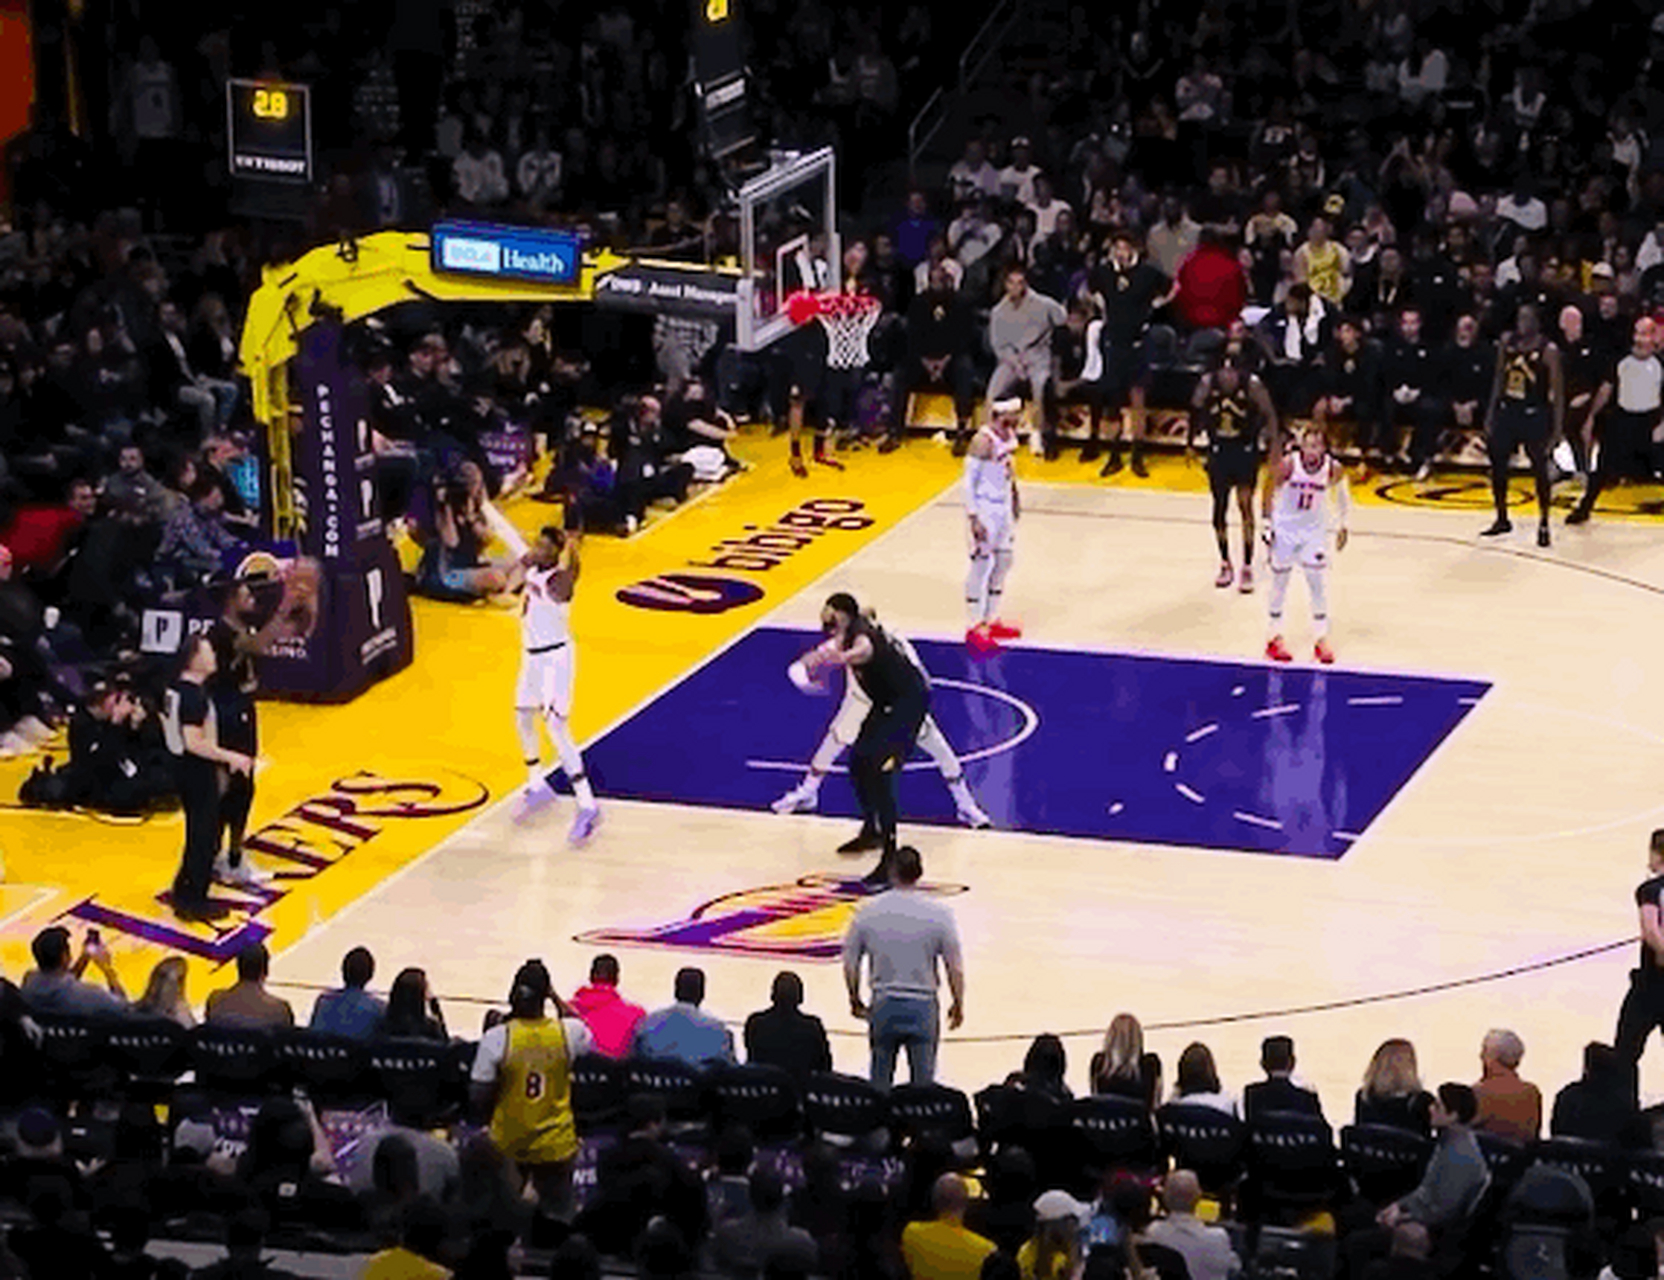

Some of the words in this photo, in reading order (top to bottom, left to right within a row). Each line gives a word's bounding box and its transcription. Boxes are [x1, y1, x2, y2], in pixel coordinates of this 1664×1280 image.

[253, 89, 288, 119] 28
[503, 247, 565, 273] Health
[316, 383, 339, 558] PECHANGA.COM
[50, 769, 491, 976] LERS
[525, 1071, 543, 1101] 8
